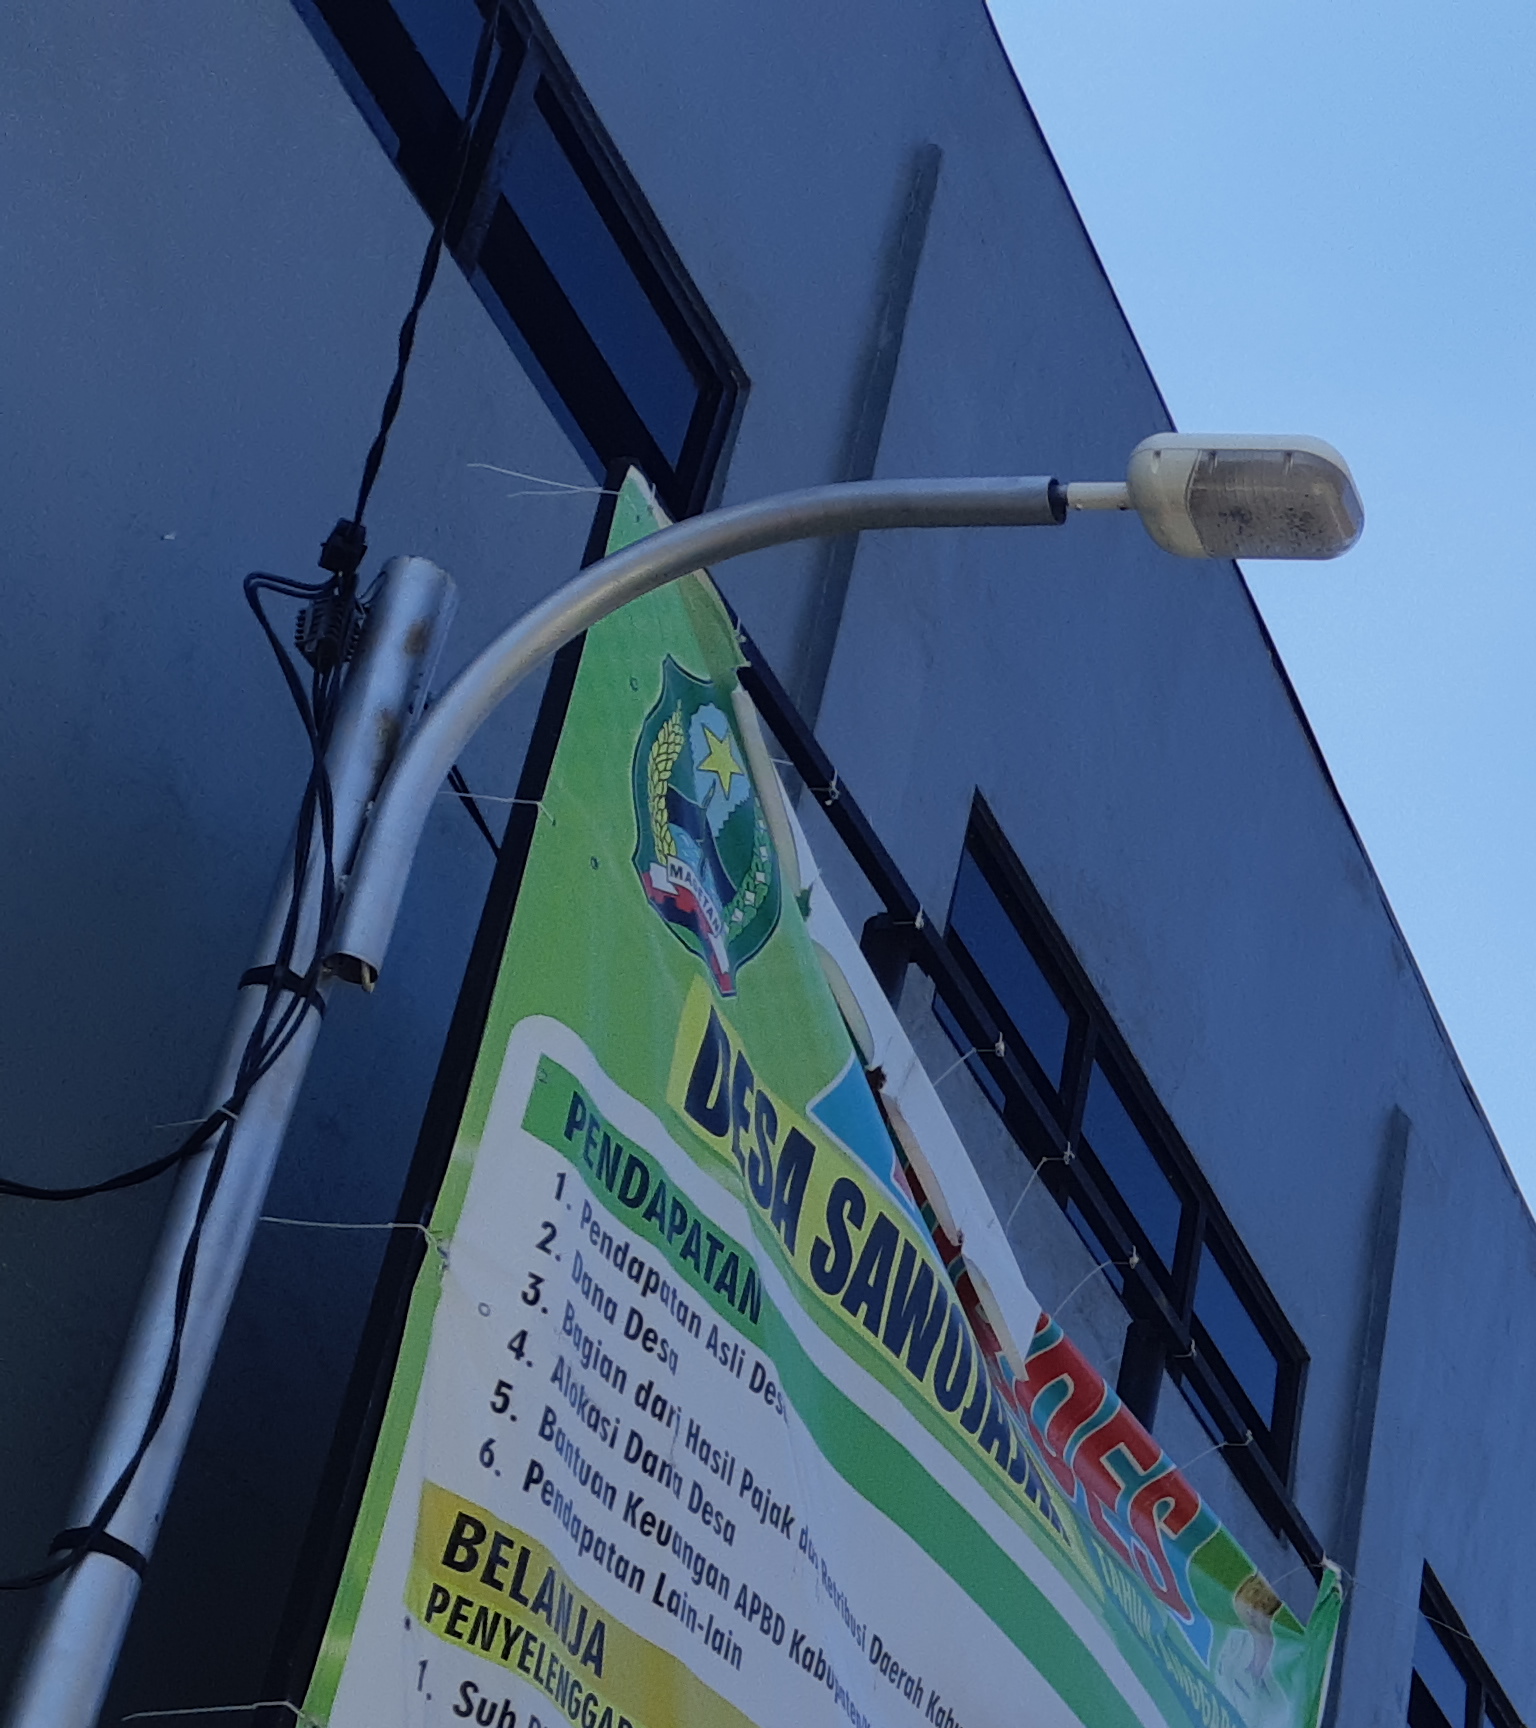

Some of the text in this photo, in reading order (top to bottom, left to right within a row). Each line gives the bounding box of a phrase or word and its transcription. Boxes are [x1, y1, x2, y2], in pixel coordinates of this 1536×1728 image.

[564, 1090, 761, 1324] PENDAPATAN
[684, 1005, 816, 1256] DESA
[571, 1250, 679, 1376] Dana Desa
[580, 1199, 701, 1339] Pendapatan
[705, 1324, 746, 1379] Asli
[538, 1405, 617, 1511] Bantuan
[623, 1490, 730, 1601] Keuangan
[734, 1583, 786, 1646] APBD
[550, 1355, 736, 1547] Alokasi Dana Desa
[562, 1300, 626, 1394] Bagian
[634, 1380, 682, 1428] dari
[686, 1418, 736, 1486] Hasil
[739, 1468, 796, 1540] Pajak
[869, 1634, 924, 1709] Daerah
[442, 1510, 605, 1679] BELANJA
[522, 1459, 744, 1671] Pendapatan Lain-lain
